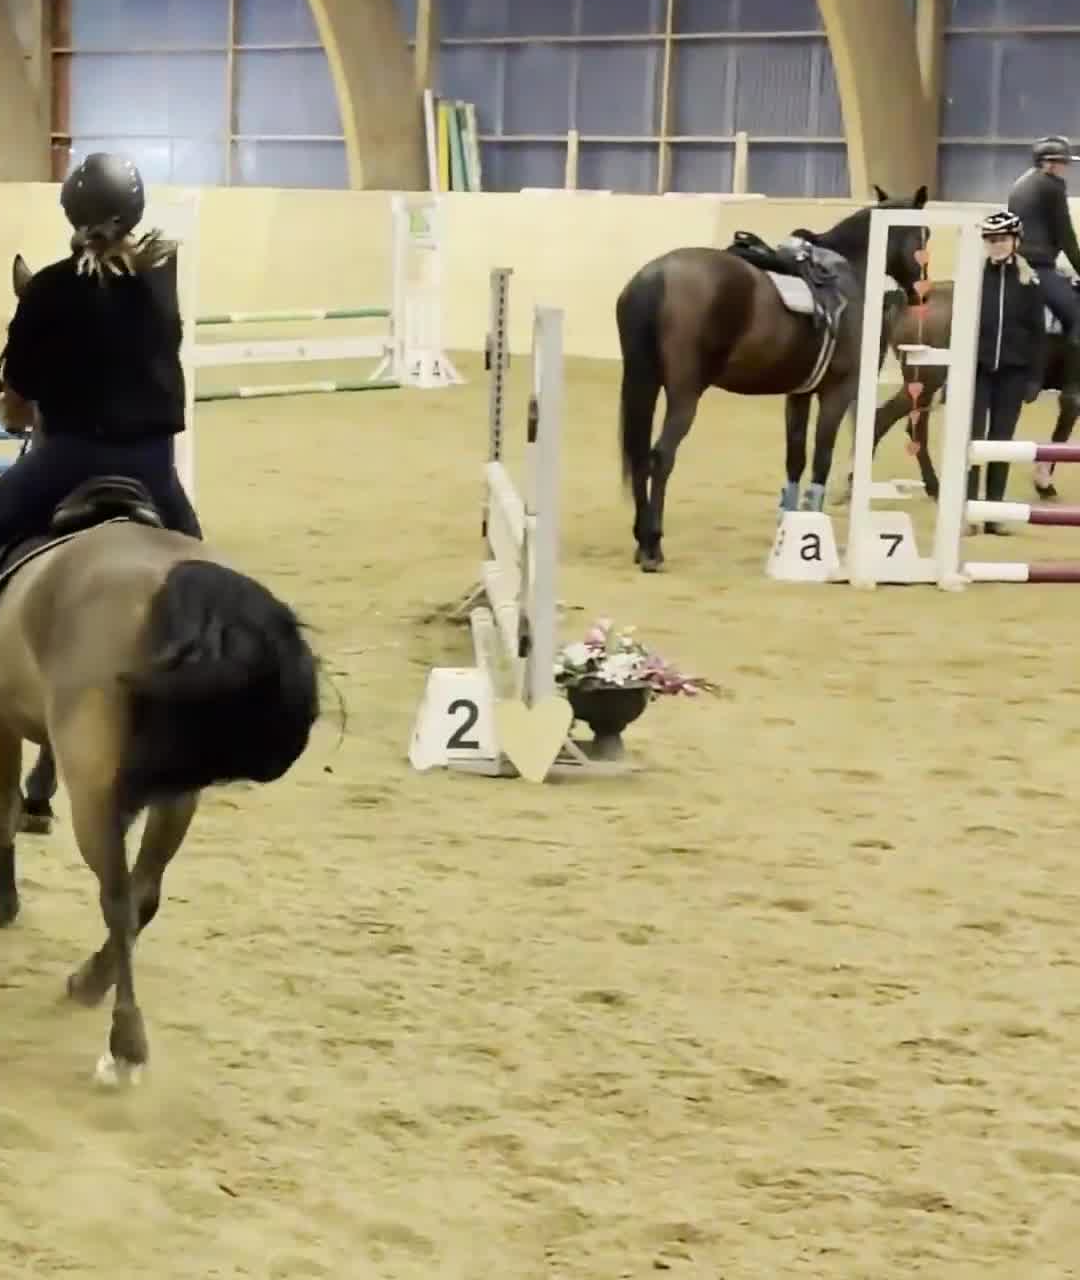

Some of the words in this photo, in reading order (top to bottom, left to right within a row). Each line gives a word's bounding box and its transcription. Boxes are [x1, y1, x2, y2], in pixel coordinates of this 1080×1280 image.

[800, 533, 822, 561] a
[879, 533, 904, 558] 7
[446, 699, 480, 749] 2
